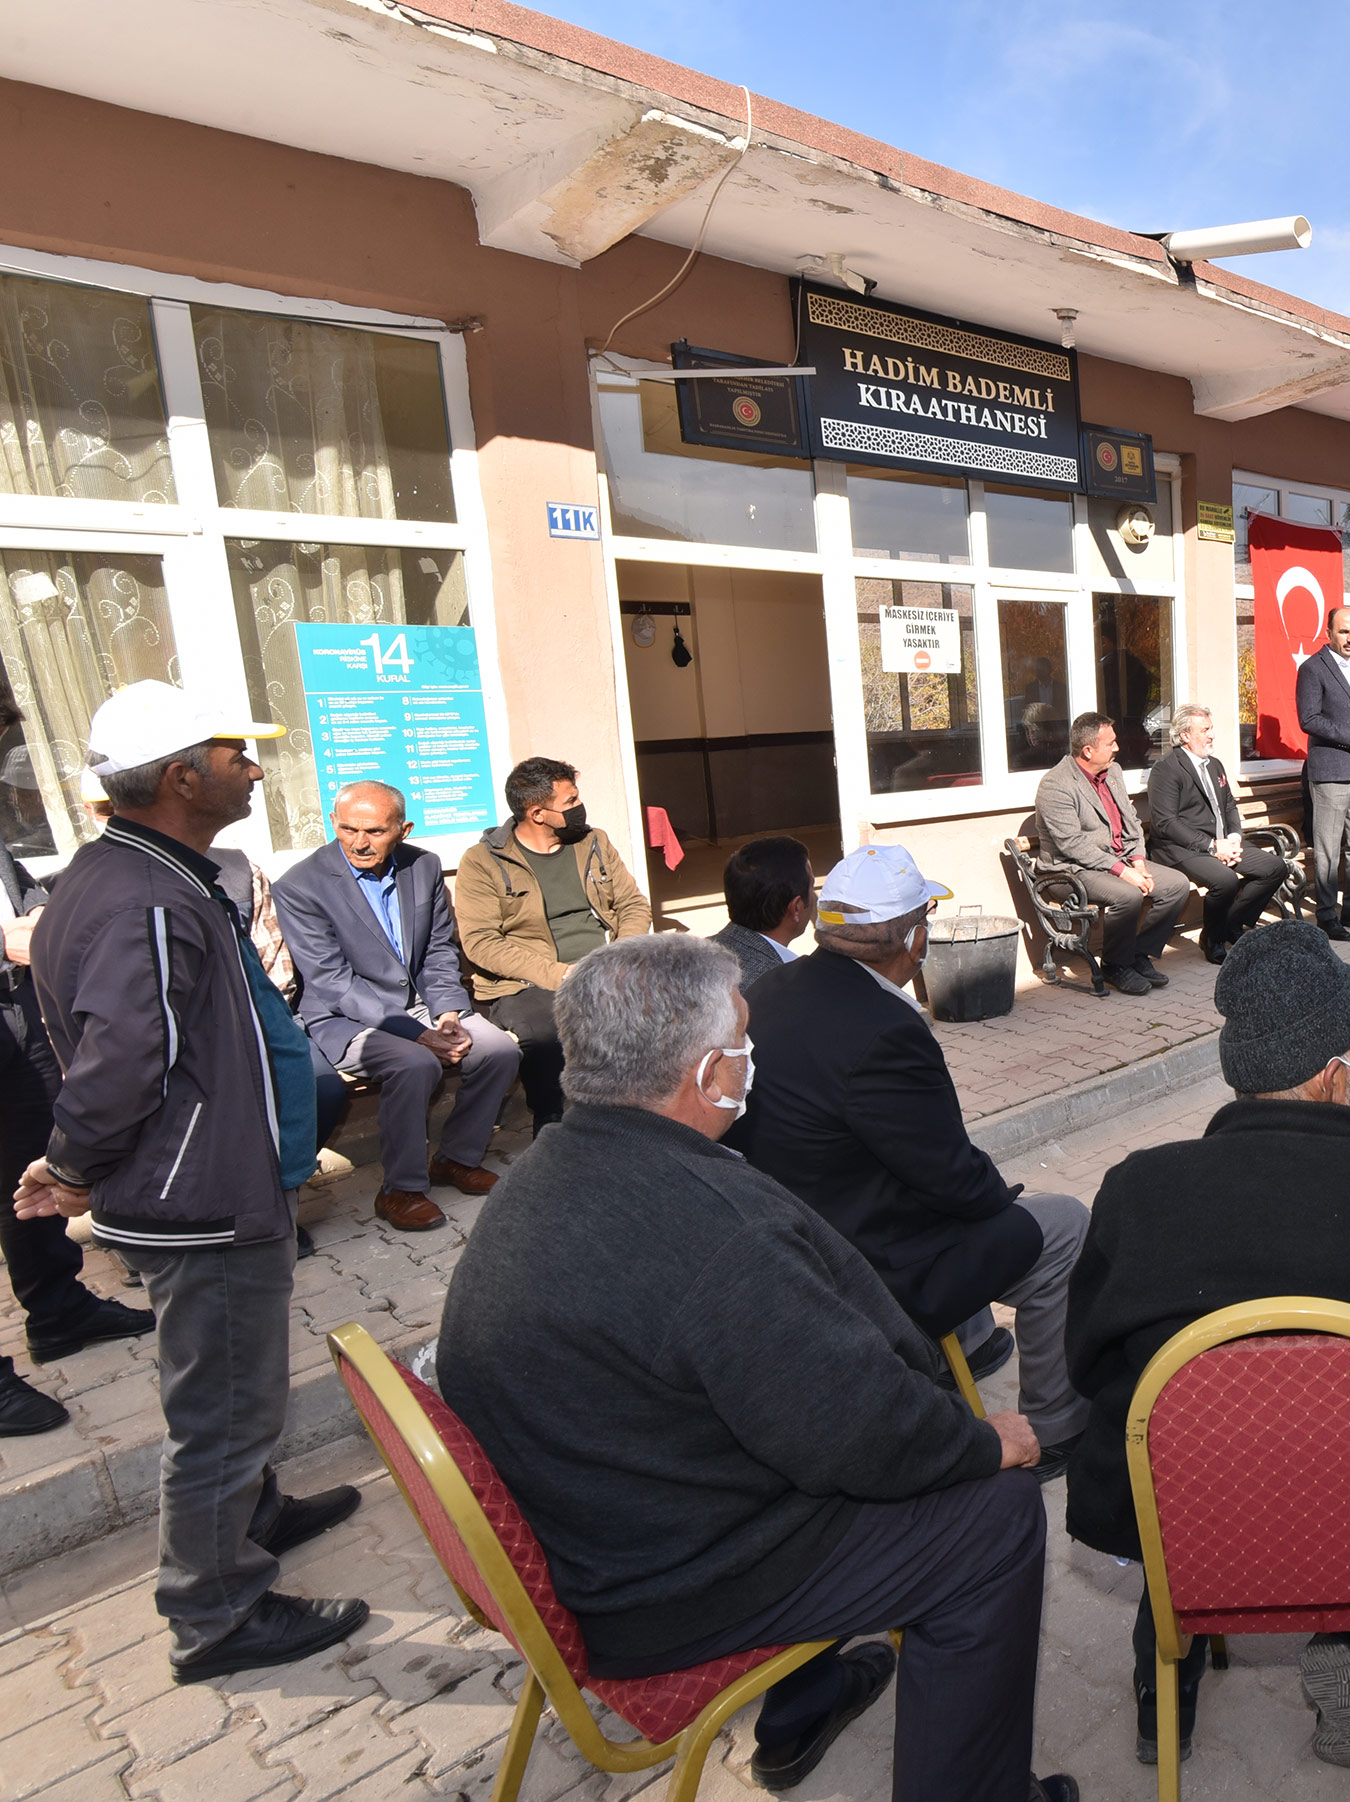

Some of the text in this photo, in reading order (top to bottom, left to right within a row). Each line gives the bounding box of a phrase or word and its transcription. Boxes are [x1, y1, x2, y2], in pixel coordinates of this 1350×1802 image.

[842, 347, 1055, 413] HADİM BADEMLİ
[857, 383, 1048, 439] KIRAATHANESİ
[885, 609, 955, 622] MASKESİZ İÇERİYE
[905, 623, 936, 635] GİRMEK
[903, 638, 940, 648] YASAKTIR
[313, 648, 367, 656] KORONAVİRÜS
[360, 632, 415, 674] 14
[346, 662, 368, 670] KARŞI
[376, 674, 411, 683] KURAL
[317, 698, 324, 708] 1
[402, 696, 409, 706] 8
[319, 715, 327, 725] 2
[404, 712, 412, 721] 9
[321, 732, 329, 741] 3
[402, 728, 414, 738] 10
[323, 748, 331, 758] 4
[405, 744, 415, 753] 11
[326, 765, 334, 774] 5
[406, 760, 418, 769] 12
[408, 776, 420, 785] 13
[328, 781, 336, 791] 6
[410, 791, 422, 801] 14
